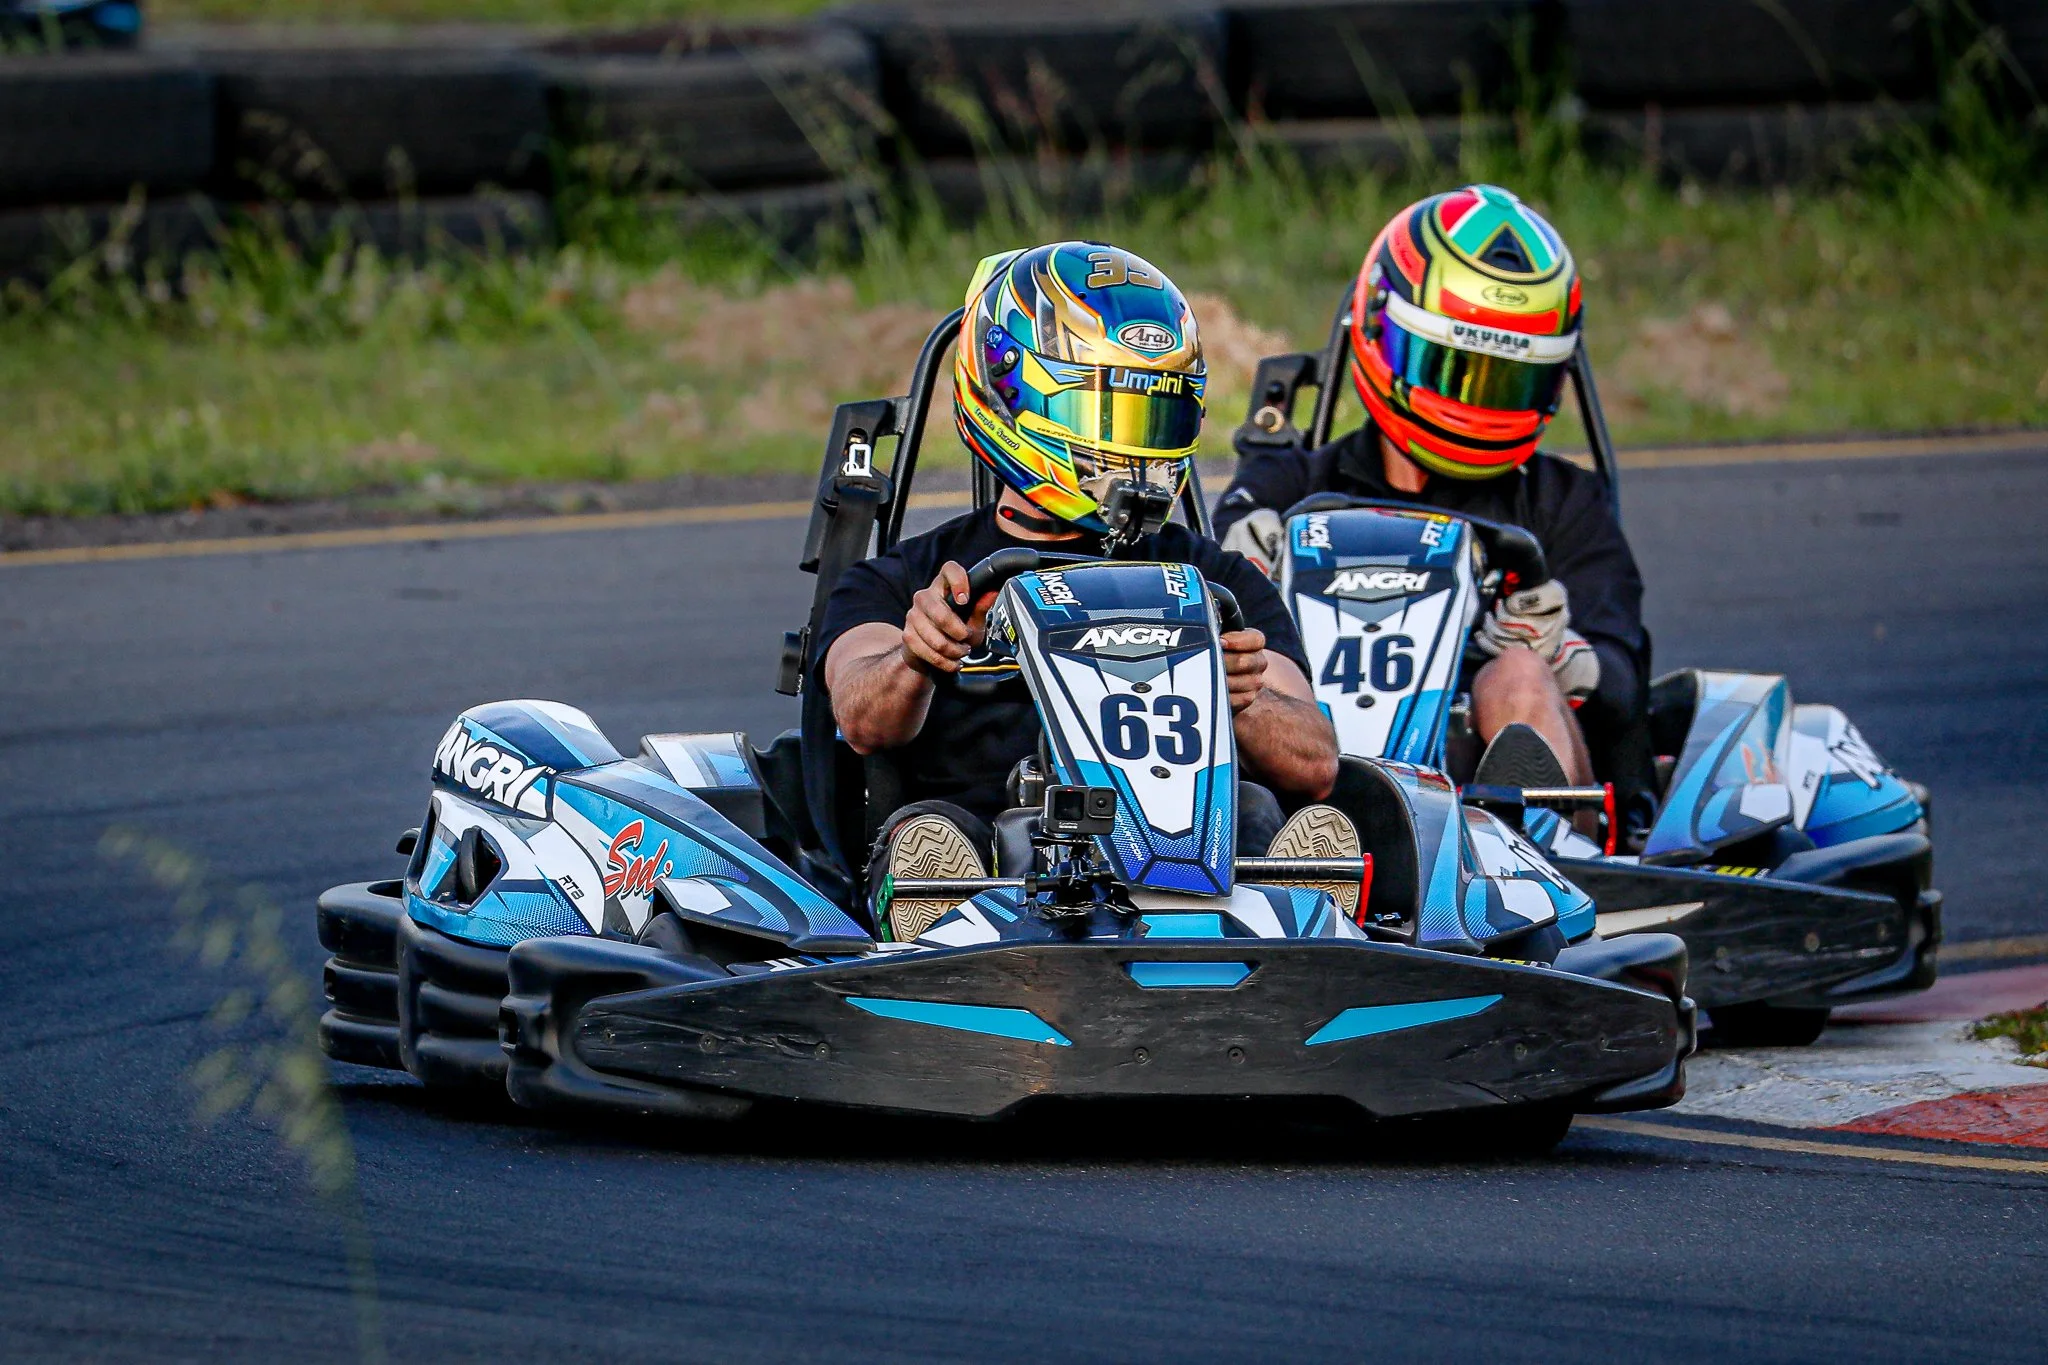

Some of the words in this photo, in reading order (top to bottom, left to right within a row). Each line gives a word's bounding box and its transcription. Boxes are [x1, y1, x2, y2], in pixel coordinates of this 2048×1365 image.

[1126, 328, 1169, 344] Arai
[1108, 367, 1184, 396] Umpini
[1036, 572, 1080, 605] ANGRI
[1322, 571, 1431, 595] ANGRI
[1071, 627, 1183, 651] ANGRI
[1319, 634, 1416, 695] 46
[1099, 693, 1203, 766] 63
[432, 720, 547, 809] ANGRI
